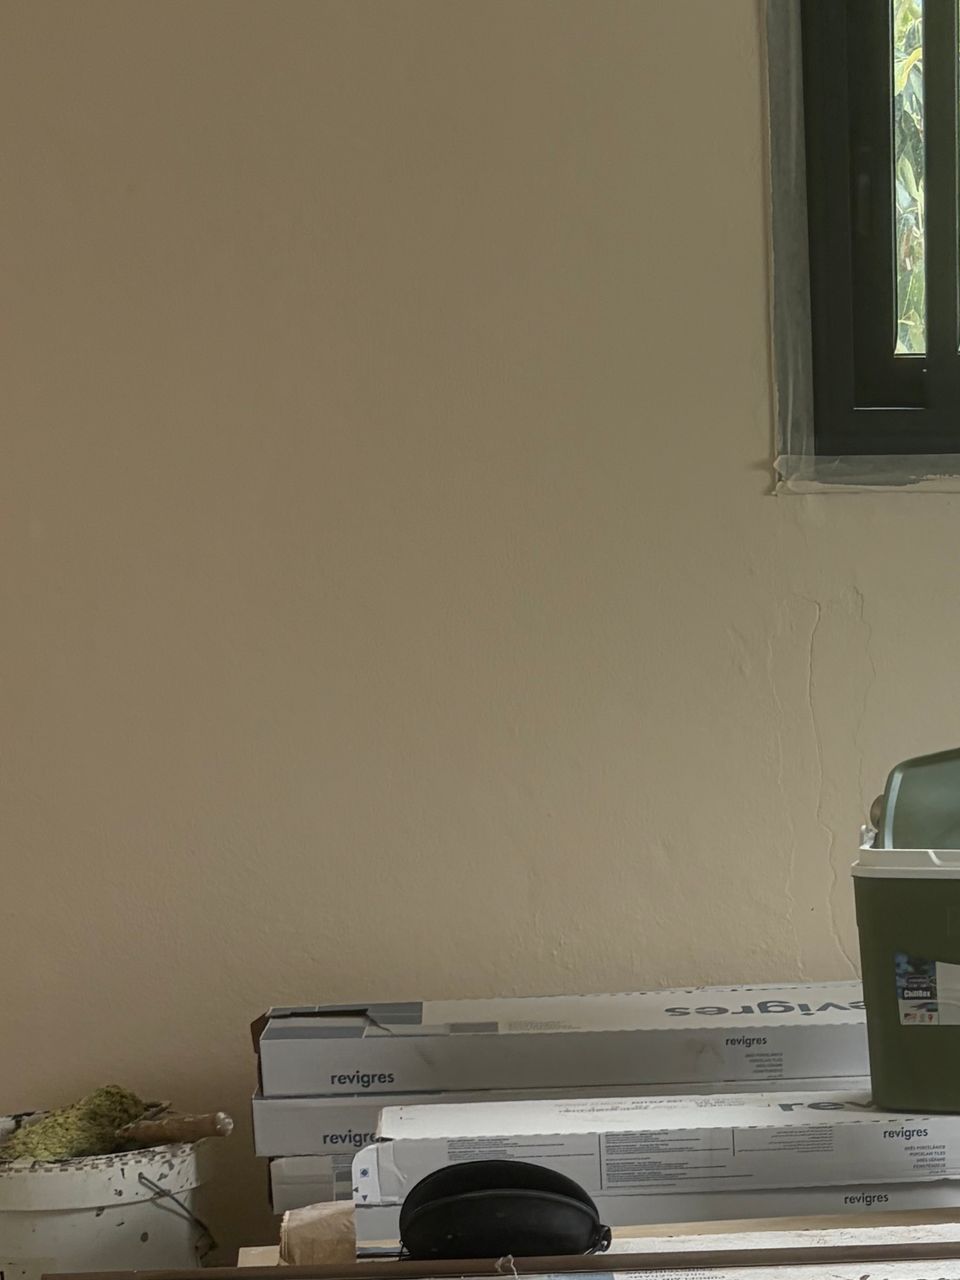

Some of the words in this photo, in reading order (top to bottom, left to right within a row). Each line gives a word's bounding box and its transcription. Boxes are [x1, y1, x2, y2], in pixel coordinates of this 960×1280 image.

[725, 1035, 768, 1048] revigres
[331, 1070, 395, 1088] revigres
[323, 1129, 377, 1147] revigre
[883, 1127, 928, 1141] revigres
[844, 1193, 889, 1206] revigres
